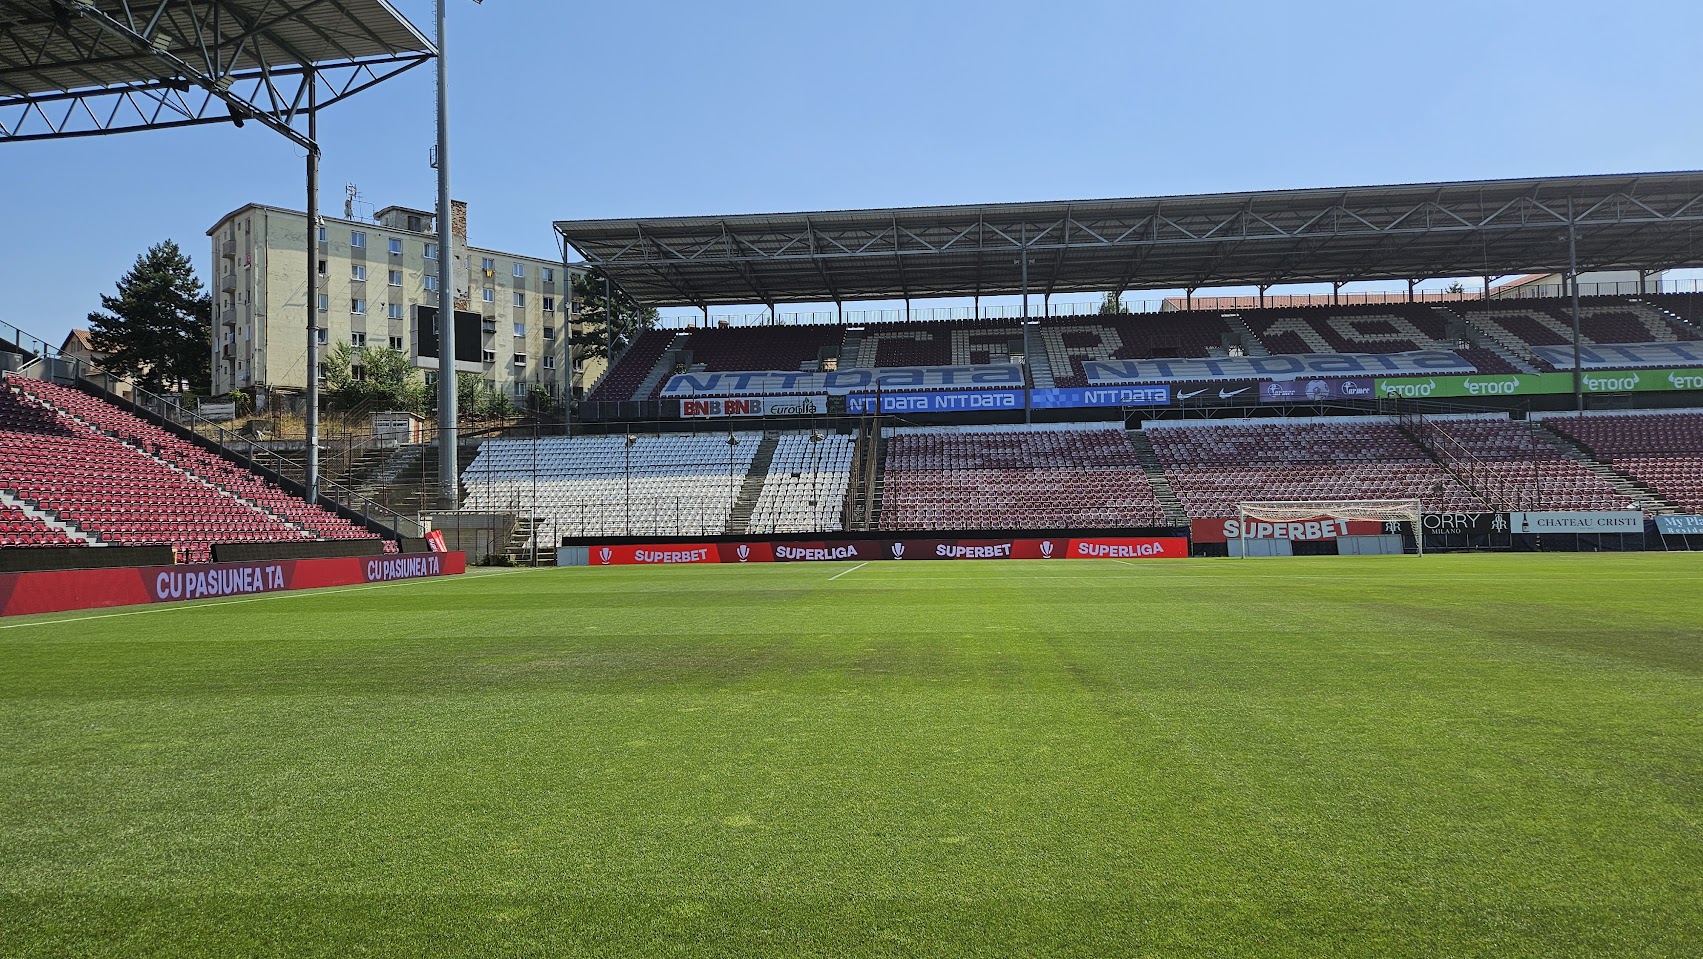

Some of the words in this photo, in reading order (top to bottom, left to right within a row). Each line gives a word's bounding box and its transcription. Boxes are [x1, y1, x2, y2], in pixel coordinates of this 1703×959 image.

[1084, 358, 1234, 380] NTT
[665, 373, 813, 392] NTT
[935, 395, 969, 409] NTT
[1084, 389, 1121, 404] NTT
[683, 400, 722, 416] BNB
[724, 399, 762, 415] BNB
[1222, 519, 1349, 540] SUPERBET
[1417, 514, 1481, 529] ORRY
[1537, 518, 1593, 527] CHATEAU
[1597, 517, 1637, 526] CRISTI
[1664, 517, 1683, 527] My
[634, 548, 708, 563] SUPERBET
[775, 544, 858, 560] SUPERLIGA
[935, 543, 1012, 558] SUPERBET
[1077, 541, 1165, 557] SUPERLIGA
[367, 560, 383, 581] CU
[383, 557, 428, 580] PASIUNEA
[428, 555, 440, 575] TA
[156, 571, 183, 599] CU
[185, 567, 264, 598] PASIUNEA
[265, 565, 285, 589] TA
